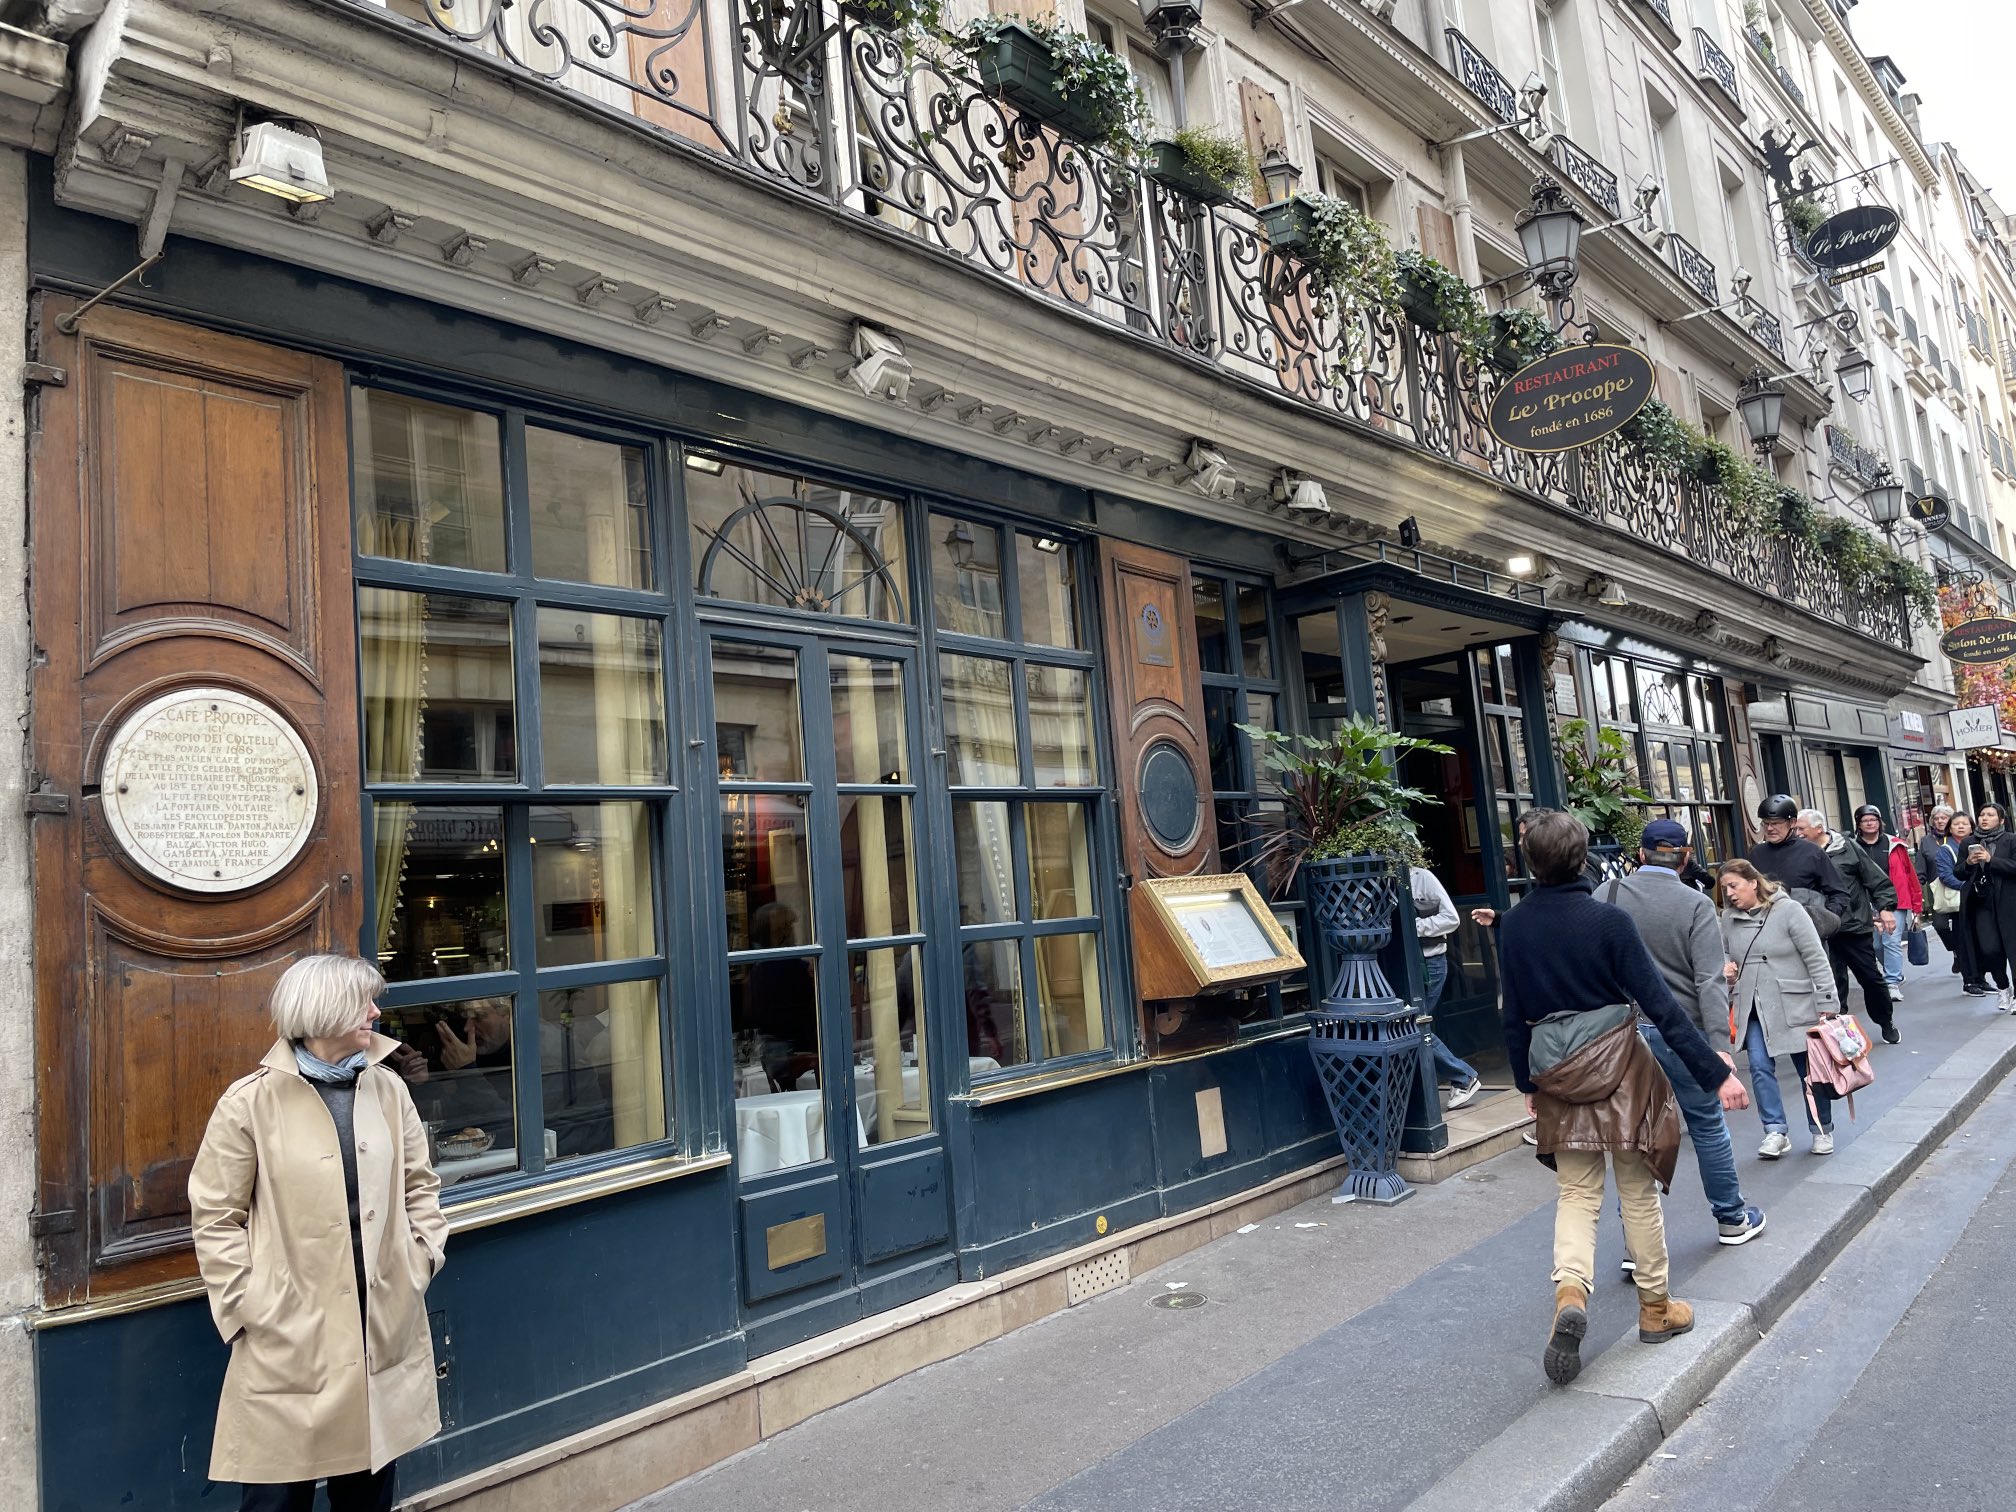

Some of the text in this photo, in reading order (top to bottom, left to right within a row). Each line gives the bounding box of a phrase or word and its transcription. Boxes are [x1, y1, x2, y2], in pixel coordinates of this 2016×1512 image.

[1812, 221, 1896, 258] Le Procope
[1866, 263, 1884, 273] 1686
[1514, 352, 1621, 395] RESTAURANT
[1508, 377, 1634, 422] Le Procope
[1530, 405, 1613, 438] fondé en 1686
[1979, 635, 1996, 645] de
[204, 710, 260, 726] PROCOPE
[208, 725, 222, 733] ICI
[145, 729, 279, 746] PROCOPIO DEI COLTELLI
[175, 745, 254, 755] FONDA EN 1686
[179, 755, 212, 763] ANCIEN
[244, 757, 256, 765] DU
[148, 763, 160, 771] ET
[162, 764, 172, 772] LE
[175, 764, 199, 772] PLUS
[191, 783, 204, 791] ET
[172, 793, 190, 801] FUT
[164, 813, 181, 821] LES
[133, 822, 176, 830] BENJAMIN
[205, 840, 238, 849] VICTOR
